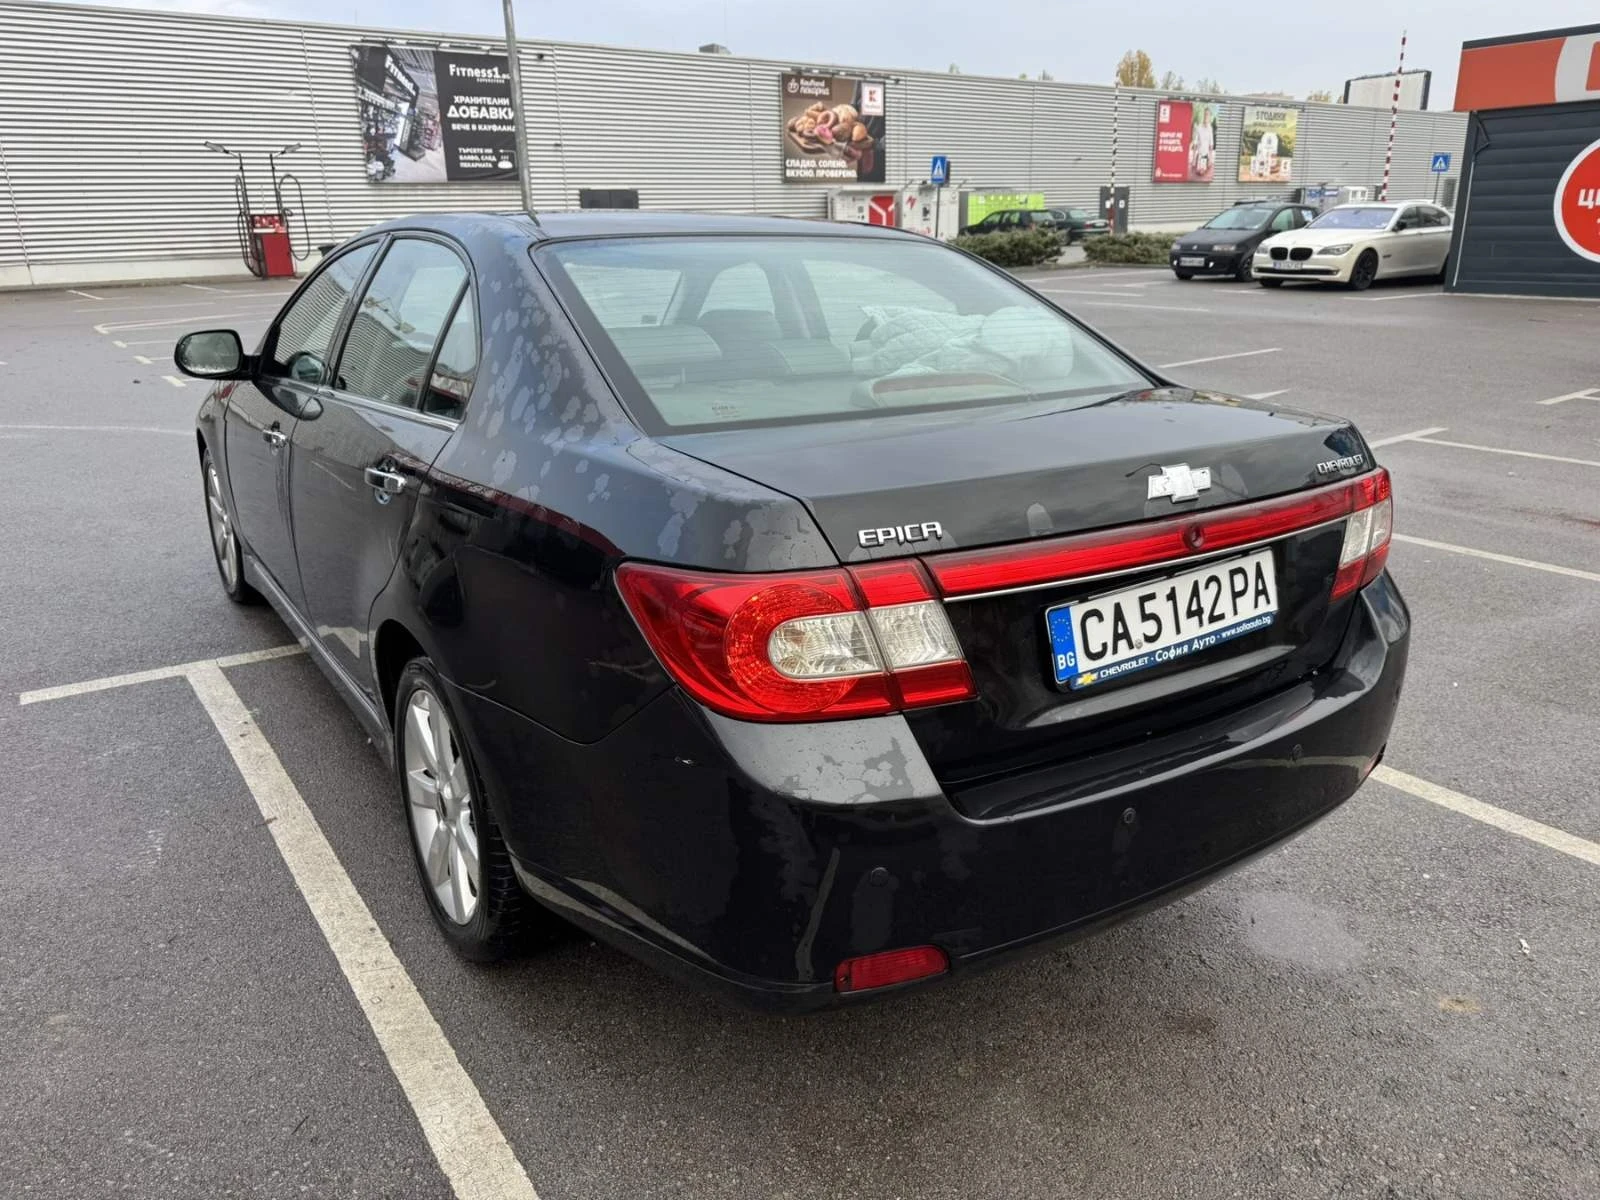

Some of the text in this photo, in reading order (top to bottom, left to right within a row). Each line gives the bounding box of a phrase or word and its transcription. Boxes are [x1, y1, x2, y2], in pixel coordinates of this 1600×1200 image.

[453, 95, 510, 106] ХРАНИТЕЛНИ
[451, 123, 470, 131] ВЕЧЕ
[471, 123, 477, 131] В
[785, 159, 848, 169] СЛАДКО. СОЛЕНО.
[785, 169, 857, 179] ВКУСНО. ПРОВЕРЕНО.
[1316, 454, 1364, 475] CHEVROLET
[858, 521, 943, 548] EPICA
[1155, 634, 1216, 662] София Ауто
[1057, 652, 1076, 670] BG
[1100, 656, 1149, 679] CHEVROLET
